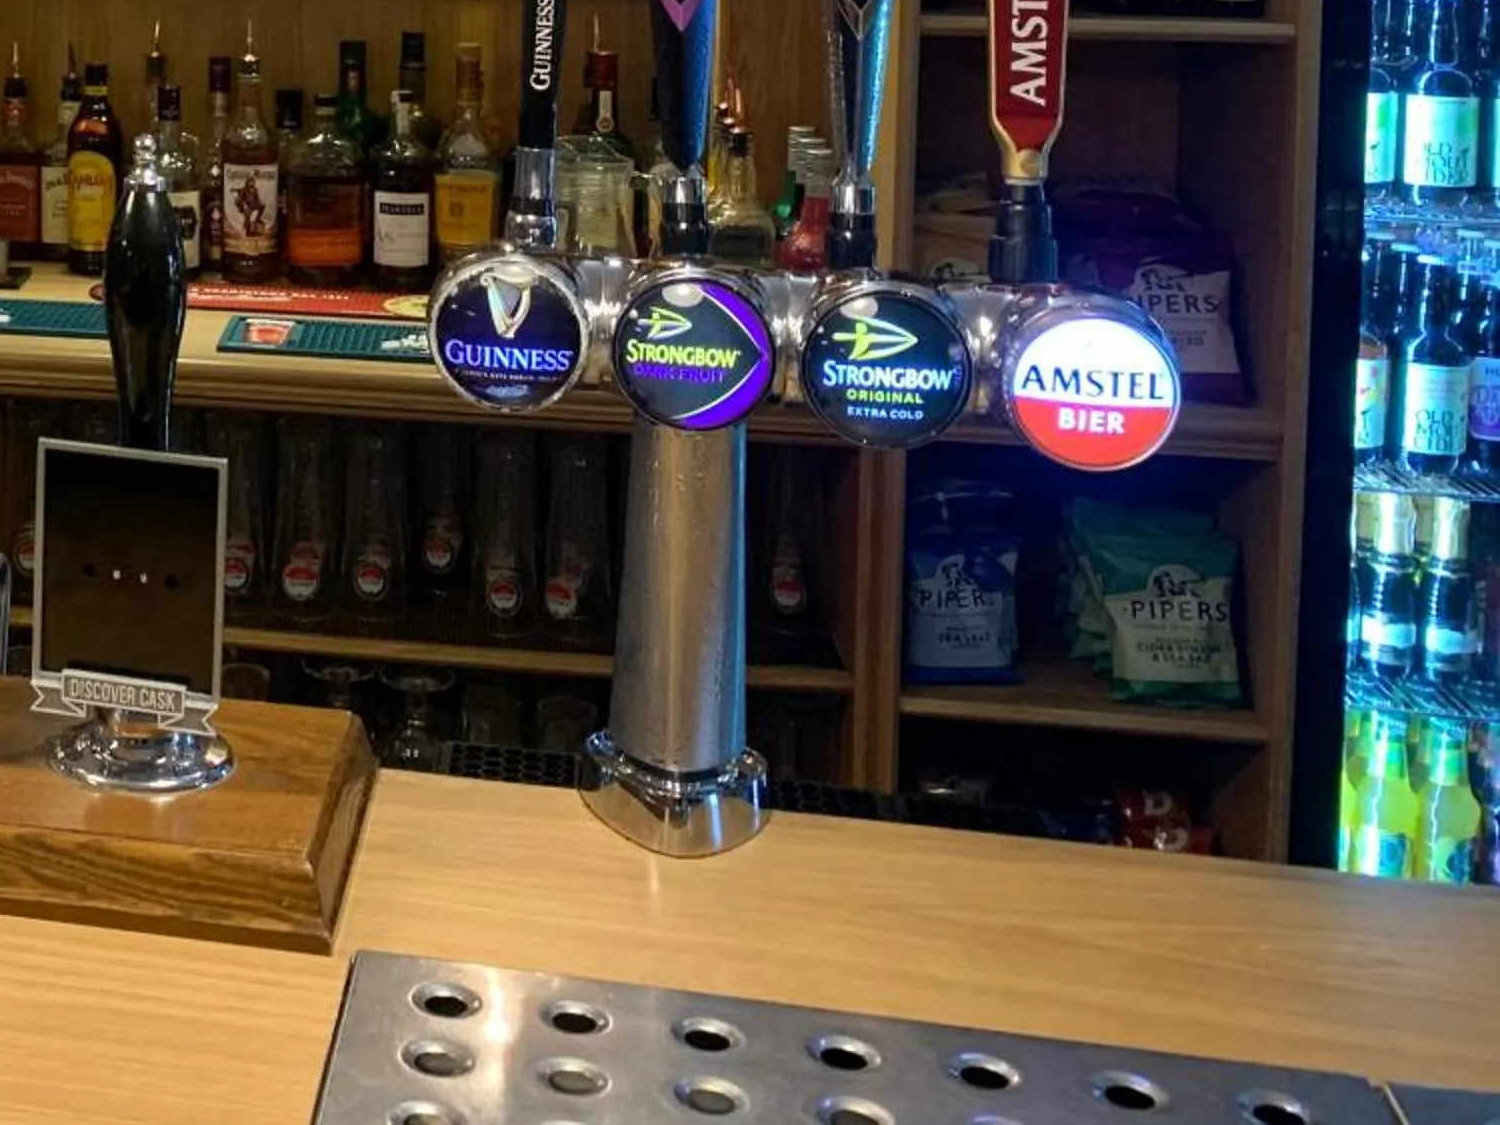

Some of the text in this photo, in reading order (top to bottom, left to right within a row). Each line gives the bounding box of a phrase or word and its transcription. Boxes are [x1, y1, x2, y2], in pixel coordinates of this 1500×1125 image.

[444, 338, 571, 372] GUINNESS
[626, 338, 737, 368] STRONGBOW
[822, 359, 953, 391] STRONGBOW
[1021, 364, 1165, 401] AMSTEL
[845, 388, 925, 405] ORIGINAL
[846, 406, 925, 421] EXTRA COLD
[1057, 408, 1126, 435] BIER
[1131, 599, 1228, 623] PIPERS
[70, 678, 176, 711] DISCOVER CASK
